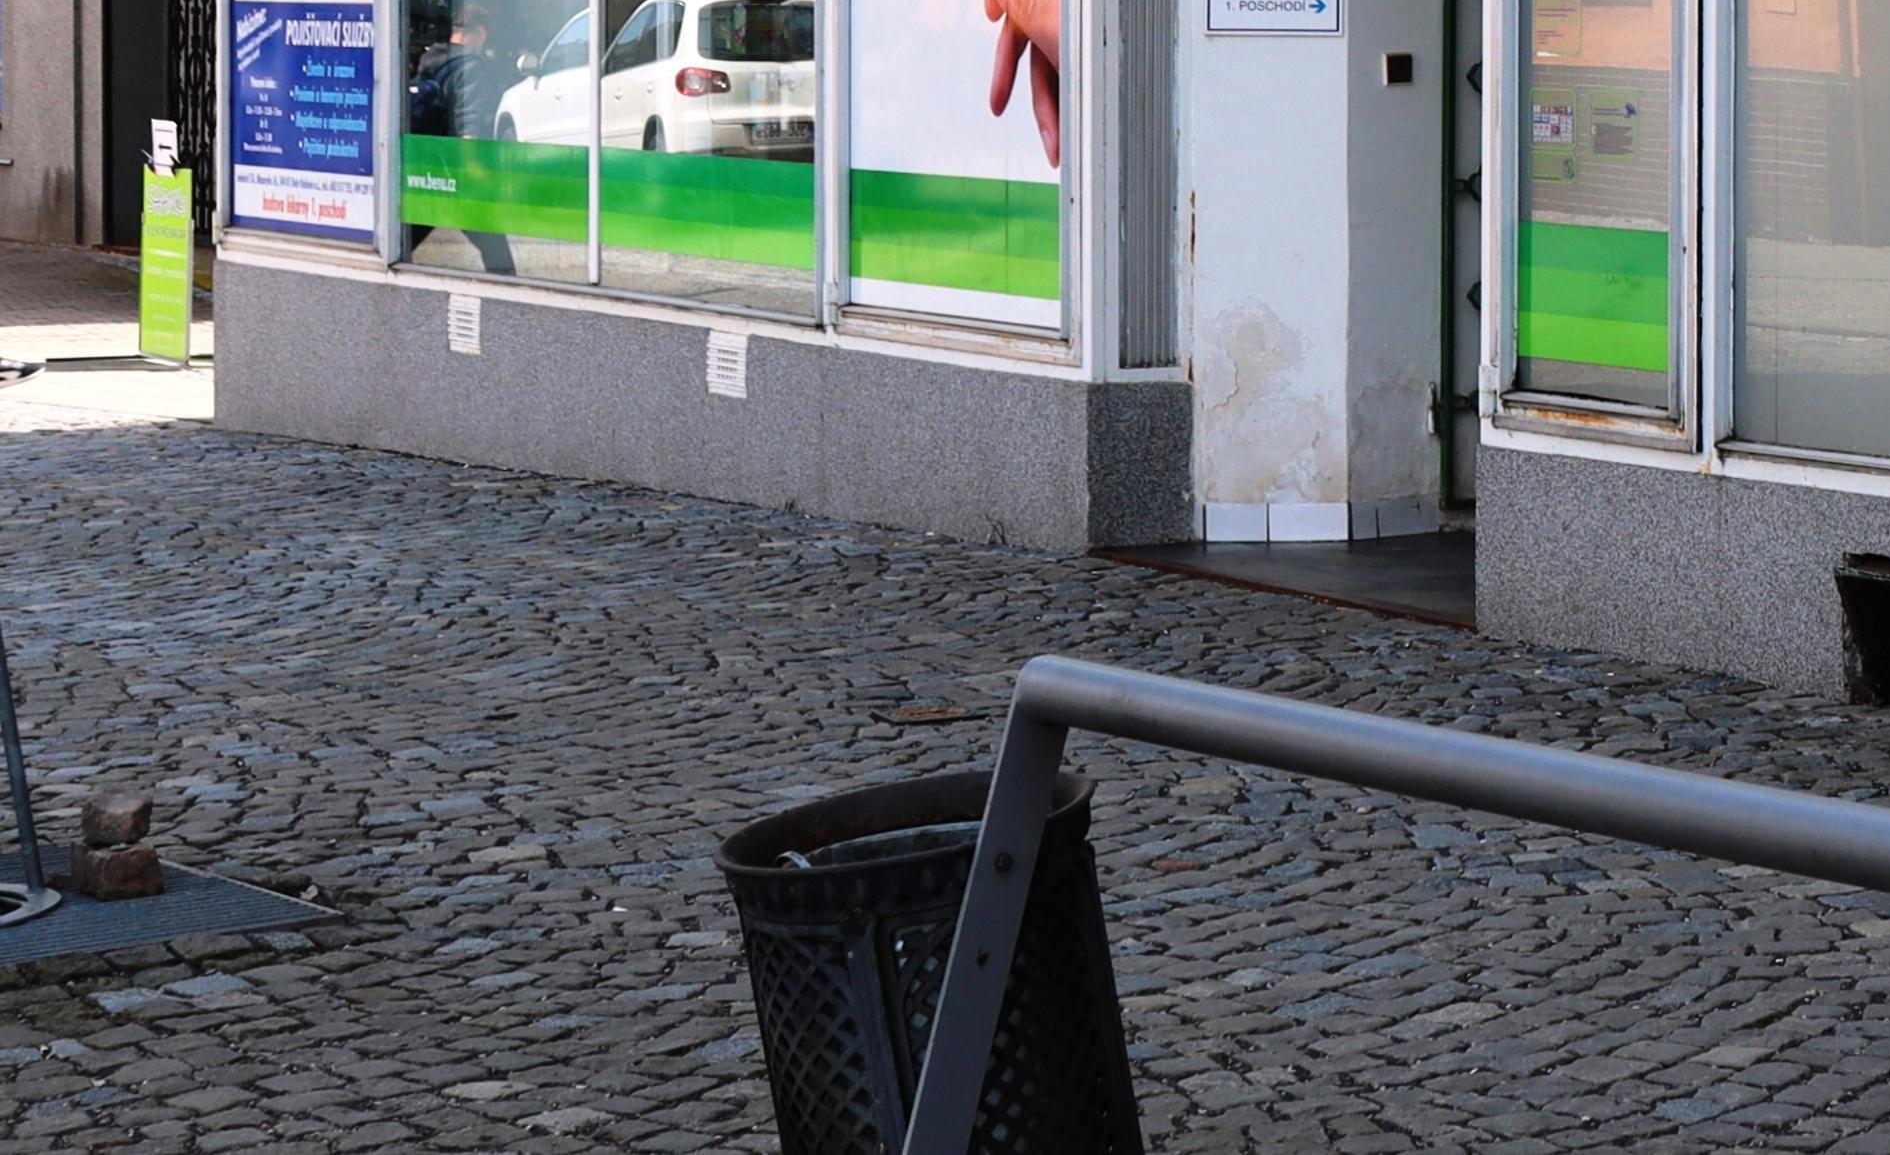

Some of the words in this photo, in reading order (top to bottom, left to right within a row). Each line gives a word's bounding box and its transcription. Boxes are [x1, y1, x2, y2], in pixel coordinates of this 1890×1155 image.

[1226, 1, 1235, 11] 1.
[1239, 0, 1305, 11] POSCHODÍ
[285, 12, 341, 46] POJIŠŤOVACÍ
[407, 172, 457, 192] www.benu.cz
